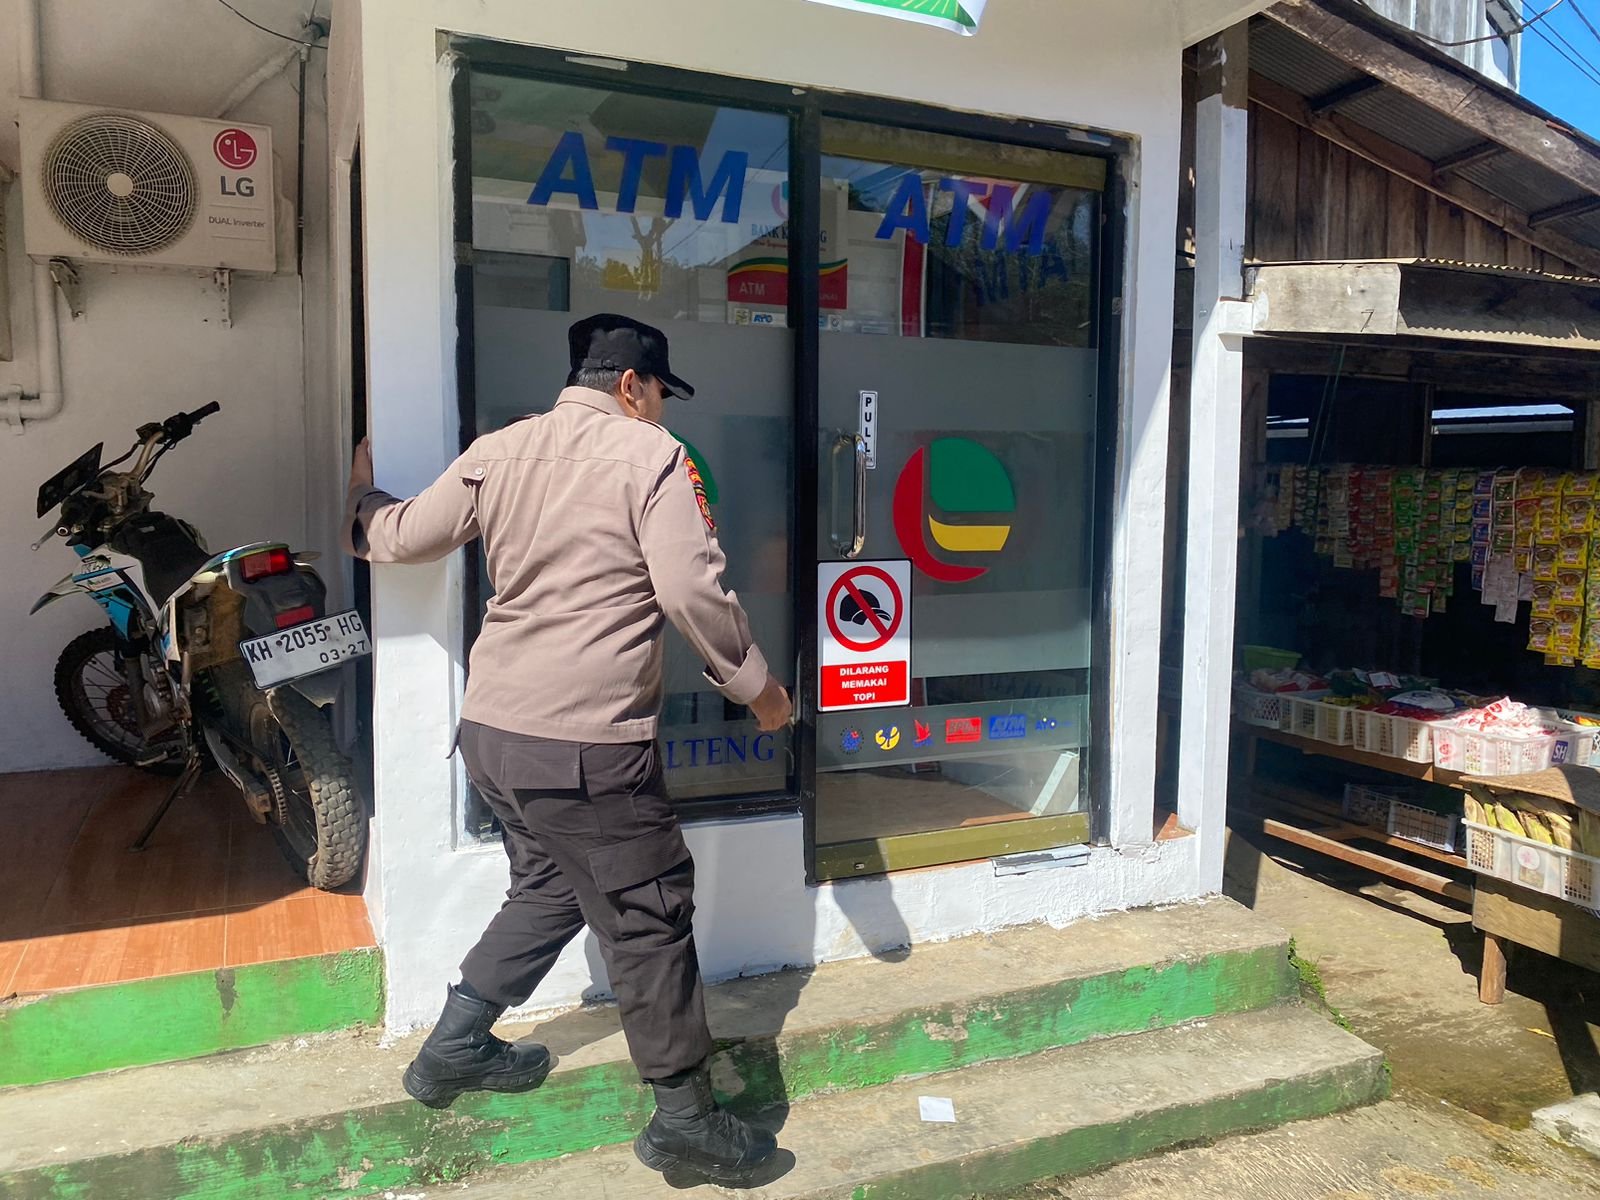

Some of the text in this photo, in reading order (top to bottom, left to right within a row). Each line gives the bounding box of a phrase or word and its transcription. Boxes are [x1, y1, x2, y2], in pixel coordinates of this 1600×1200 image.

[526, 130, 749, 224] ATM
[220, 175, 255, 197] LG
[208, 216, 265, 228] DUAL Inverter
[874, 173, 1055, 257] ATM
[752, 223, 779, 238] BANK
[739, 281, 766, 296] ATM
[245, 640, 273, 663] KH
[280, 623, 328, 653] 2055
[839, 665, 889, 677] DILARANG
[841, 678, 887, 689] MEMAKAI
[853, 692, 876, 701] TOPI
[666, 734, 775, 769] LTENG
